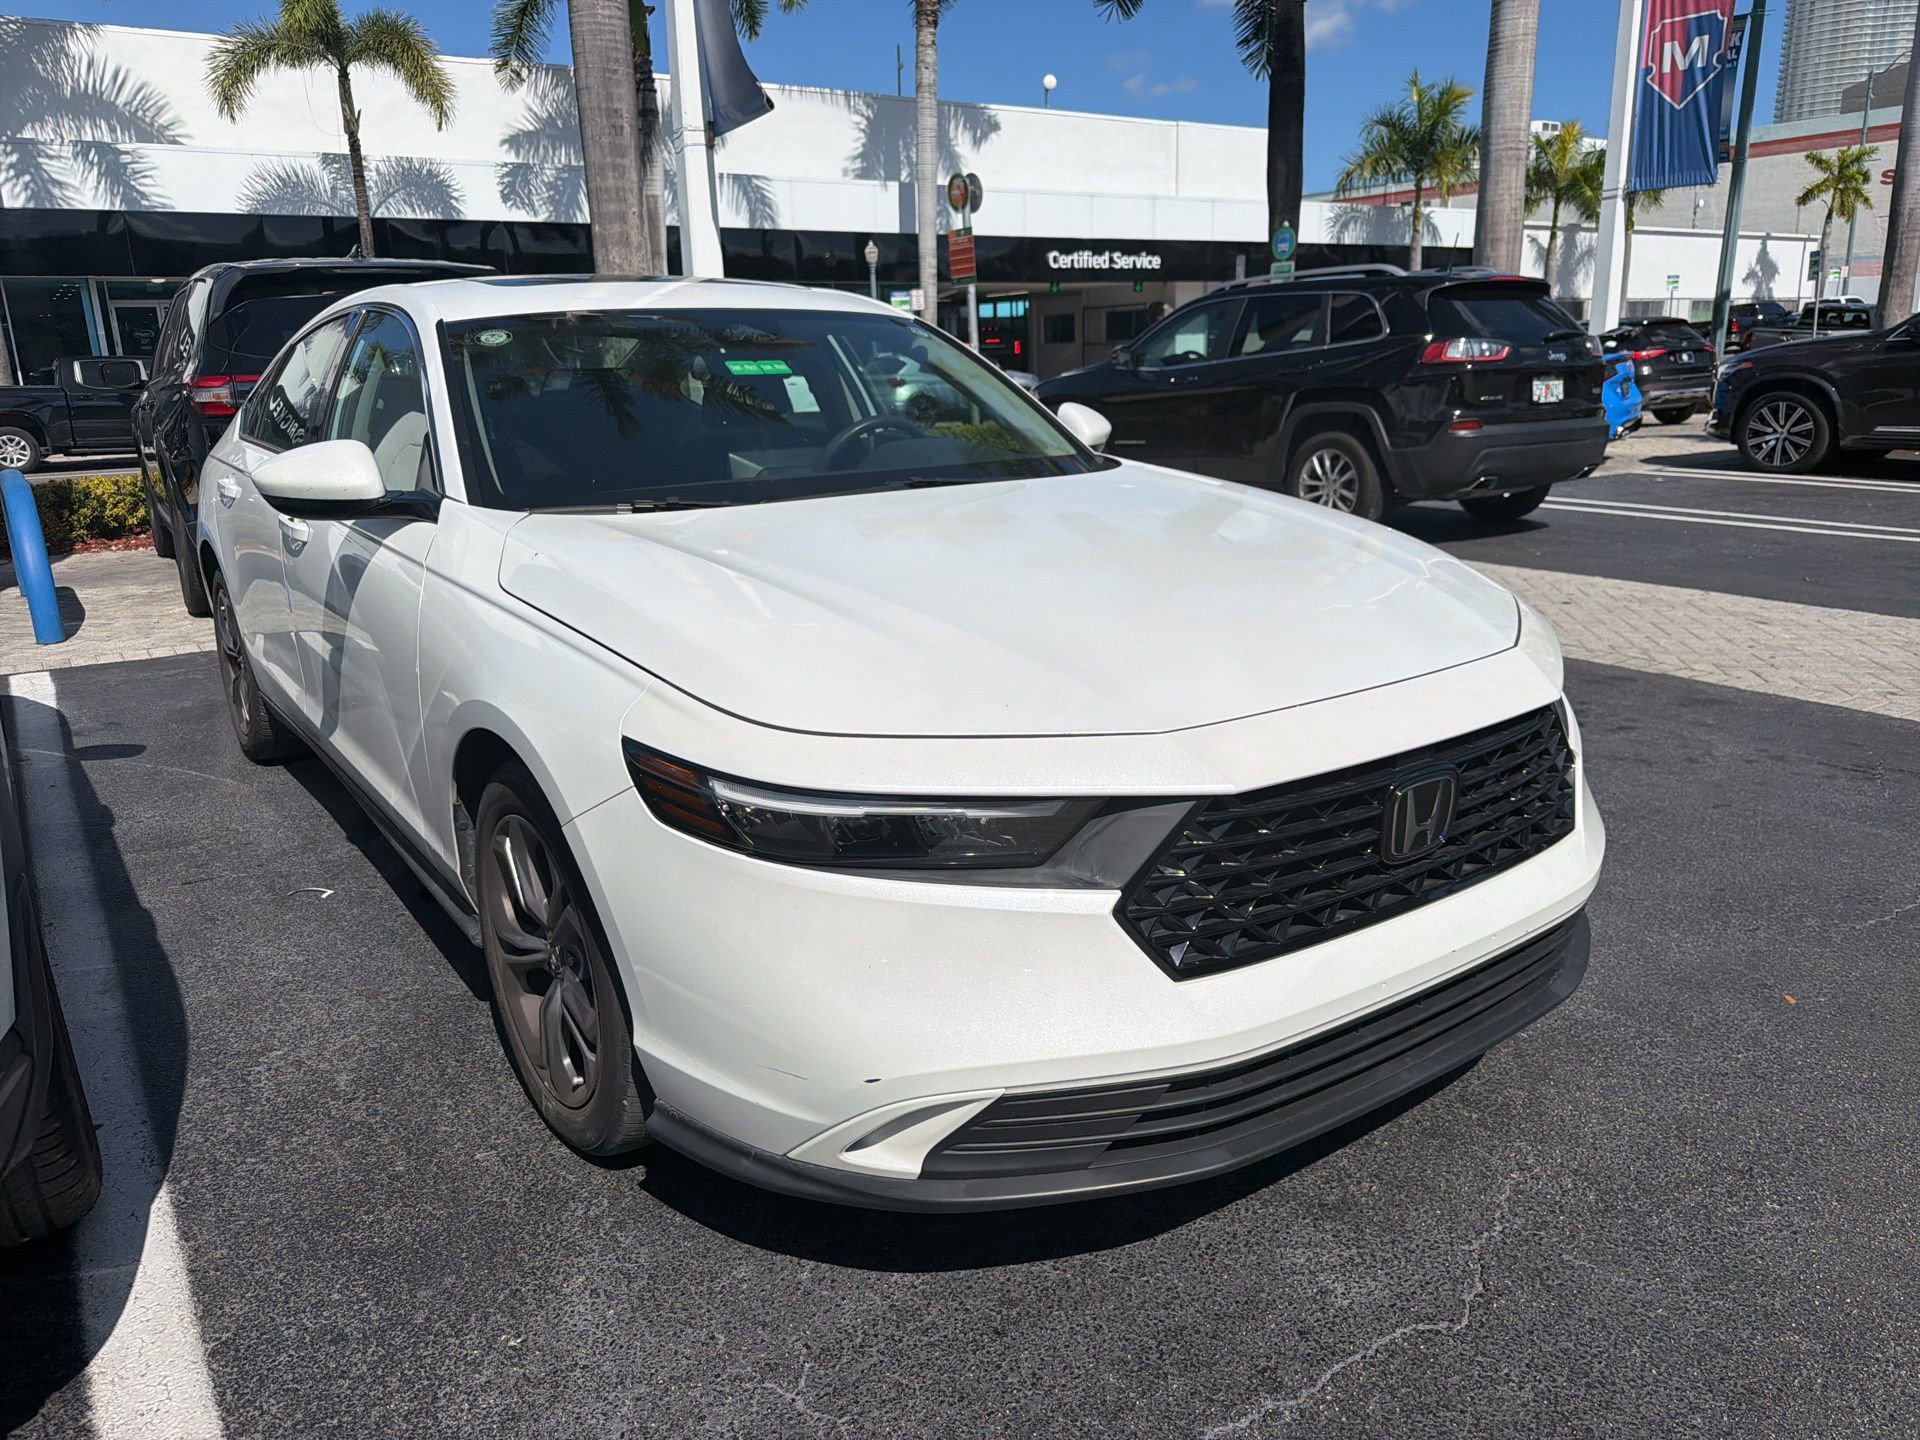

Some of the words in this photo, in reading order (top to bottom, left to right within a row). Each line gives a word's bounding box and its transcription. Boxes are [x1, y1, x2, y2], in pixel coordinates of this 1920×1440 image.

[1661, 34, 1710, 74] M
[1047, 250, 1110, 269] Certified
[1110, 251, 1162, 269] Service
